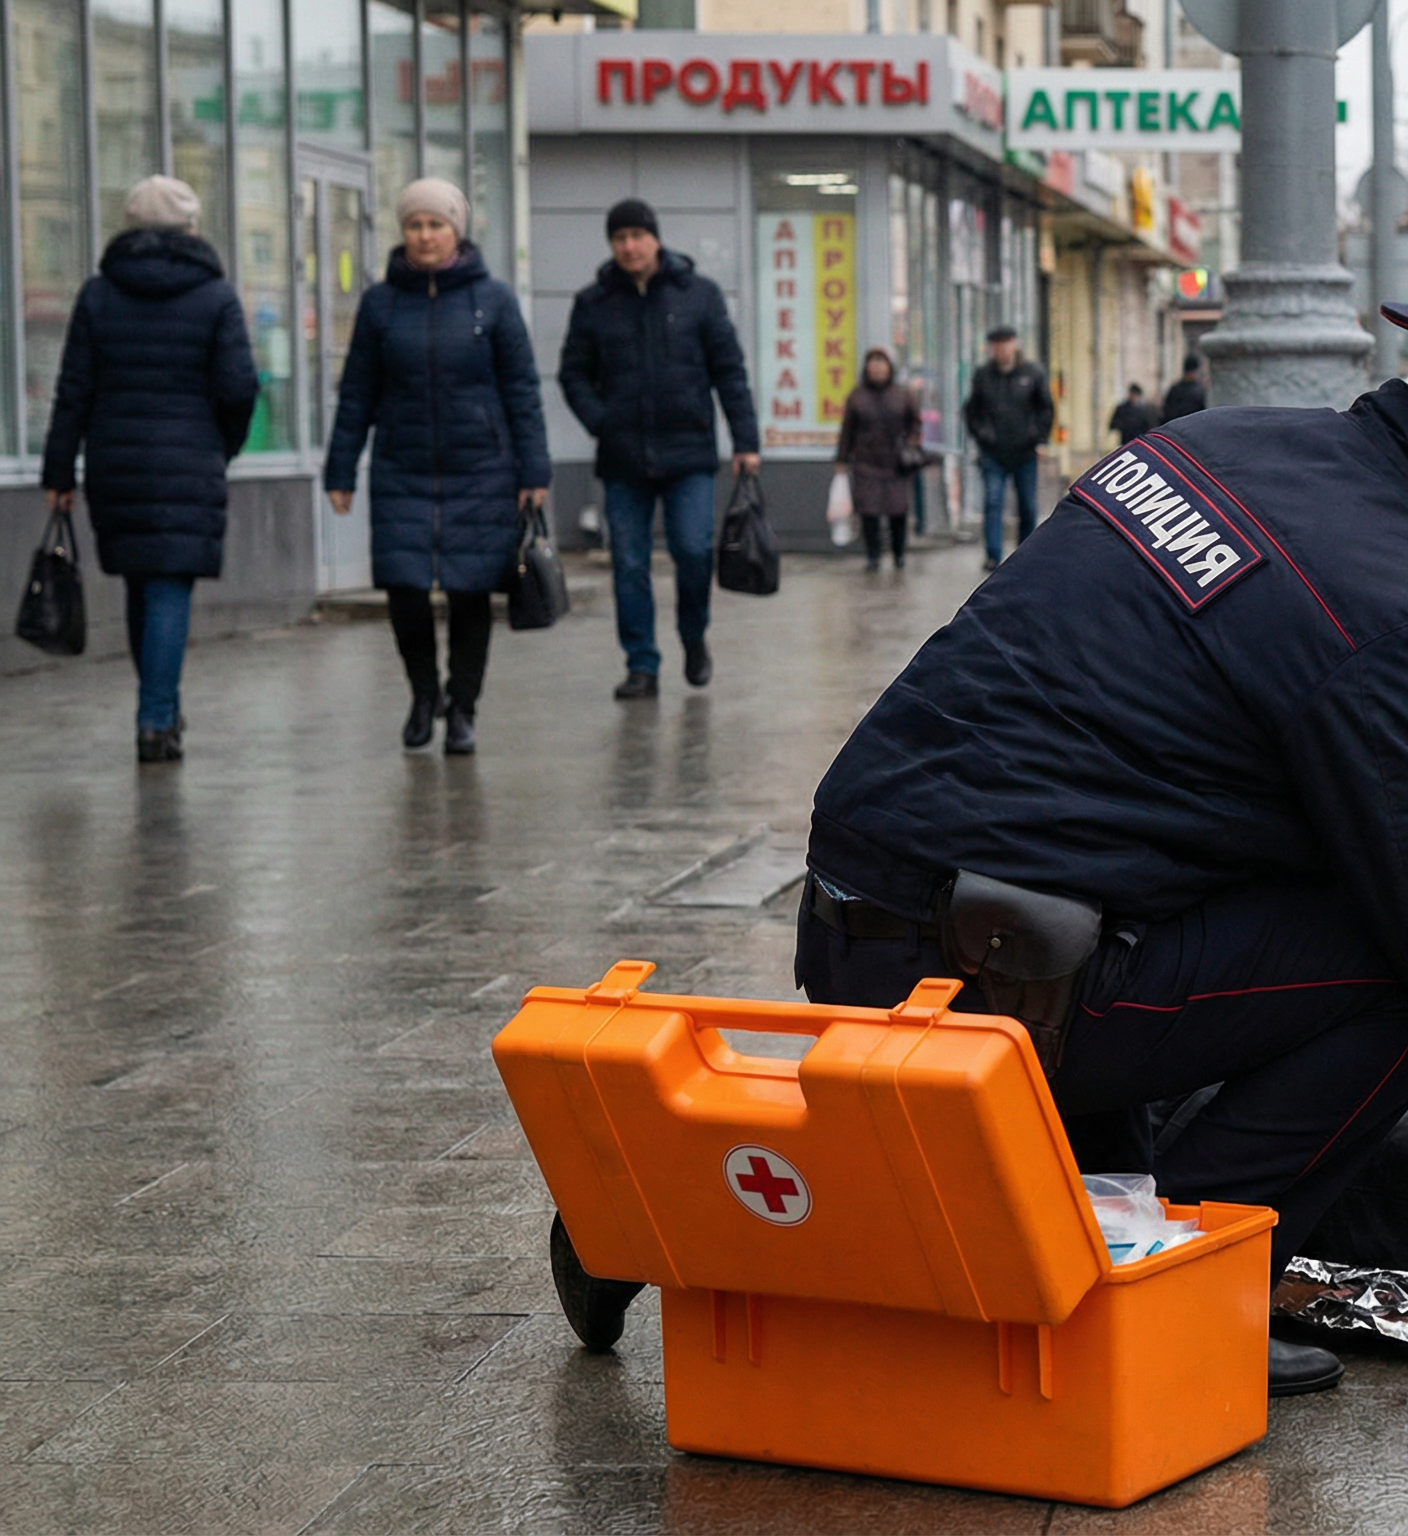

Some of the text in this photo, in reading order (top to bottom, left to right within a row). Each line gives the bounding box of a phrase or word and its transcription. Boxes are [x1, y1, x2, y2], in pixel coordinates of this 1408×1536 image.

[597, 58, 929, 111] ПРОДУКТЫ
[1021, 90, 1241, 131] АПТЕКА
[1091, 451, 1241, 587] ПОЛИЦИЯ
